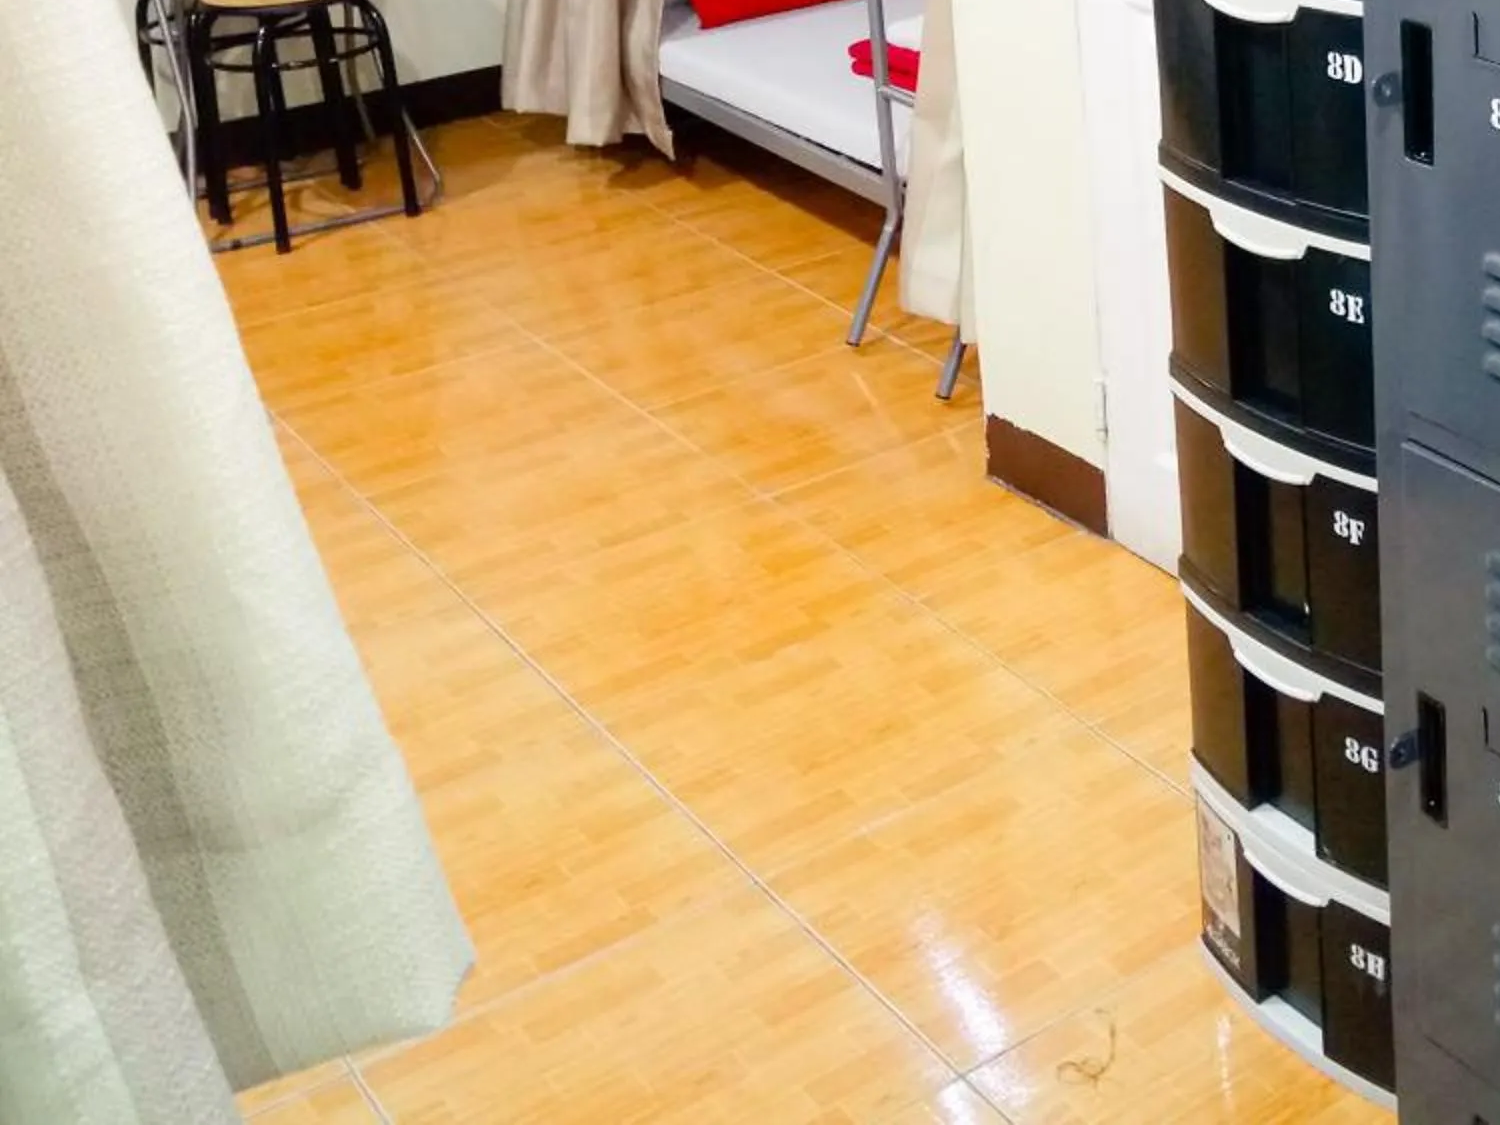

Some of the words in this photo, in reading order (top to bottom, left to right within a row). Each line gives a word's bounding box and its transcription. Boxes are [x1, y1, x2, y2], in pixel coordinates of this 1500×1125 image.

[1327, 51, 1363, 84] 8D
[1329, 289, 1365, 324] 8E
[1333, 510, 1365, 545] 8F
[1345, 737, 1378, 773] 8G
[1350, 944, 1385, 981] 8H
